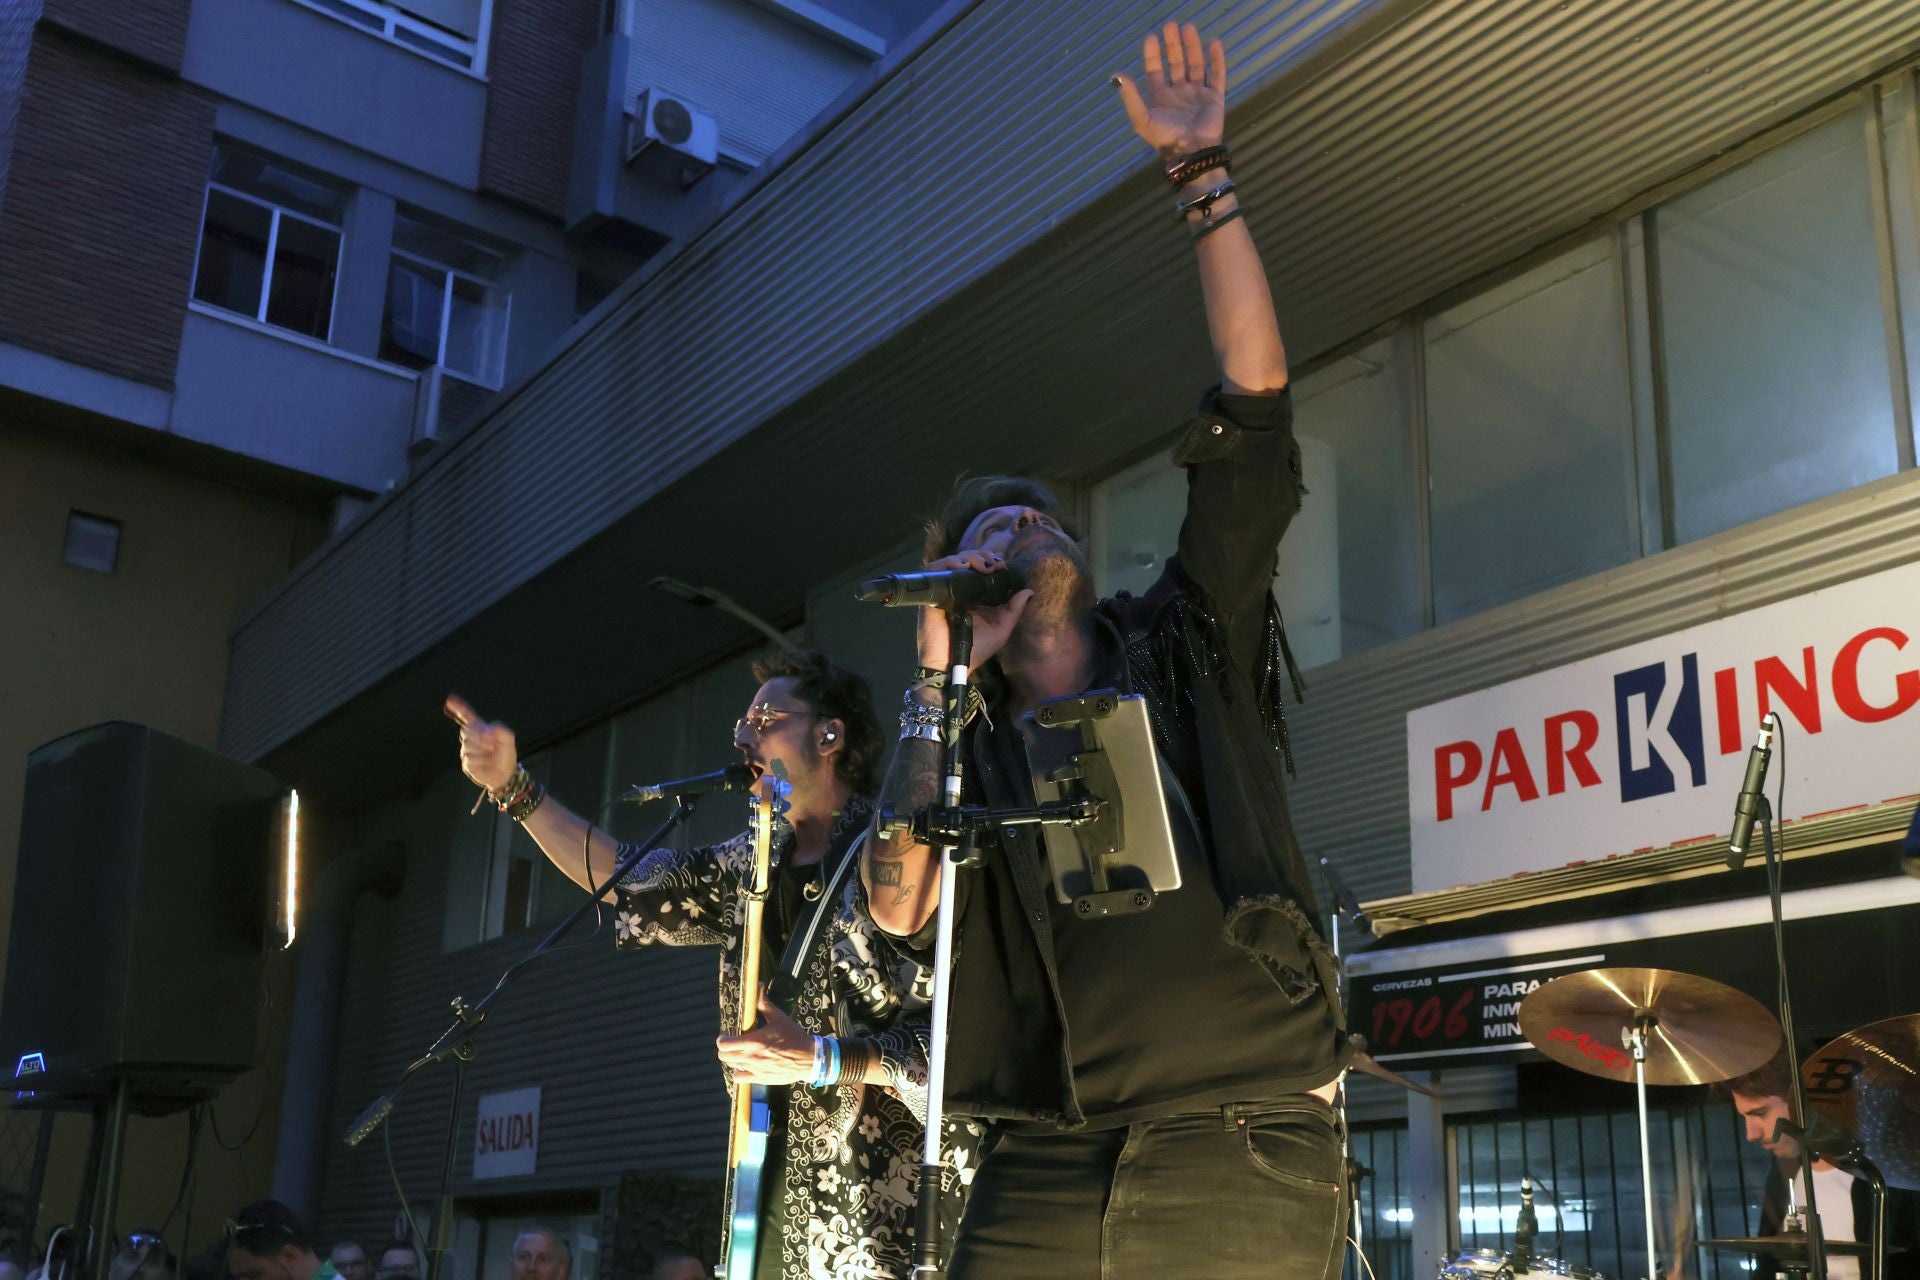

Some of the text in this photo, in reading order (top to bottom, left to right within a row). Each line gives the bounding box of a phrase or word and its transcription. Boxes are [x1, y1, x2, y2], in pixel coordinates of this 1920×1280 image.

[1433, 626, 1920, 823] PARKING
[1372, 978, 1433, 992] CERVEZAS
[1484, 979, 1541, 999] PARA
[1371, 985, 1475, 1048] 1906
[1483, 1001, 1522, 1019] INM
[1484, 1021, 1522, 1039] MIN
[478, 1111, 533, 1155] SALIDA
